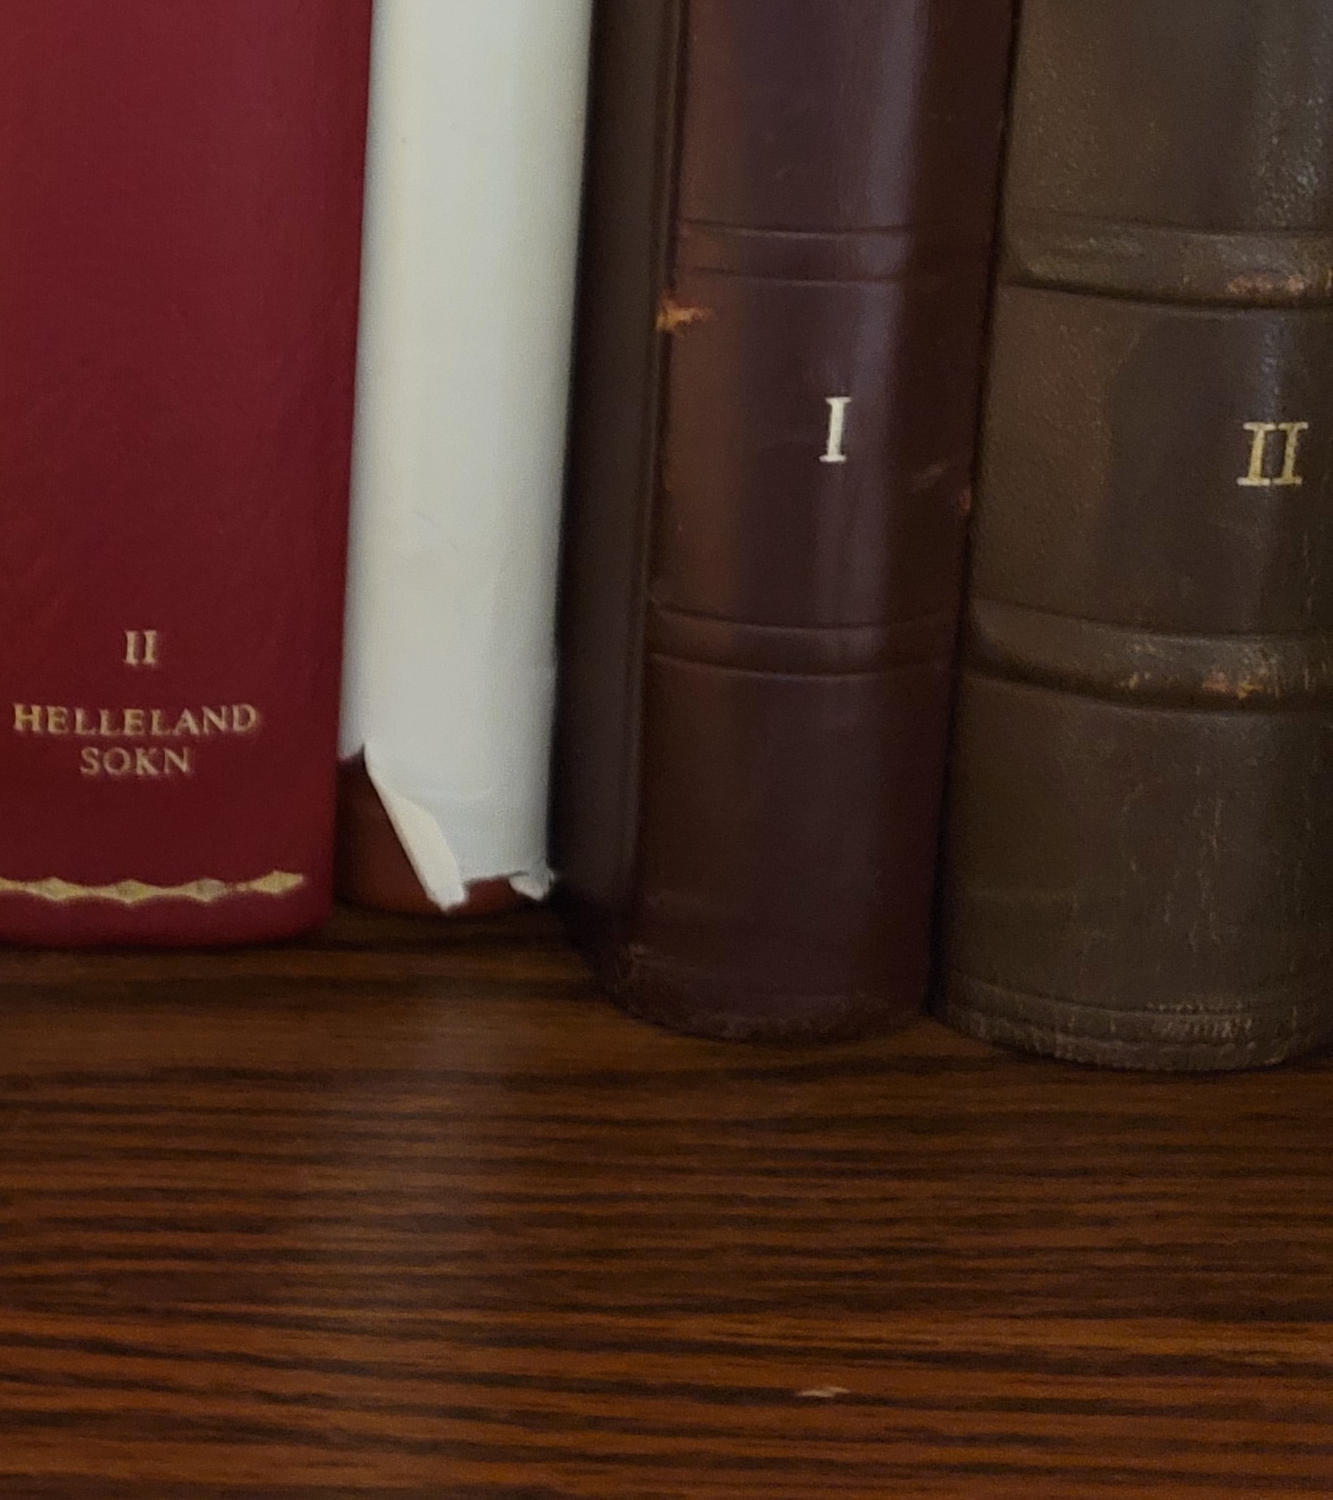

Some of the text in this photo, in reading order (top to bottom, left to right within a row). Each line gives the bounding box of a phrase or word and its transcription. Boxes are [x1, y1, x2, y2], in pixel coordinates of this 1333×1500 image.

[818, 396, 851, 463] I
[1236, 420, 1309, 487] II
[124, 629, 158, 666] II
[12, 702, 261, 737] HELLELAND
[80, 746, 191, 776] SOKN
